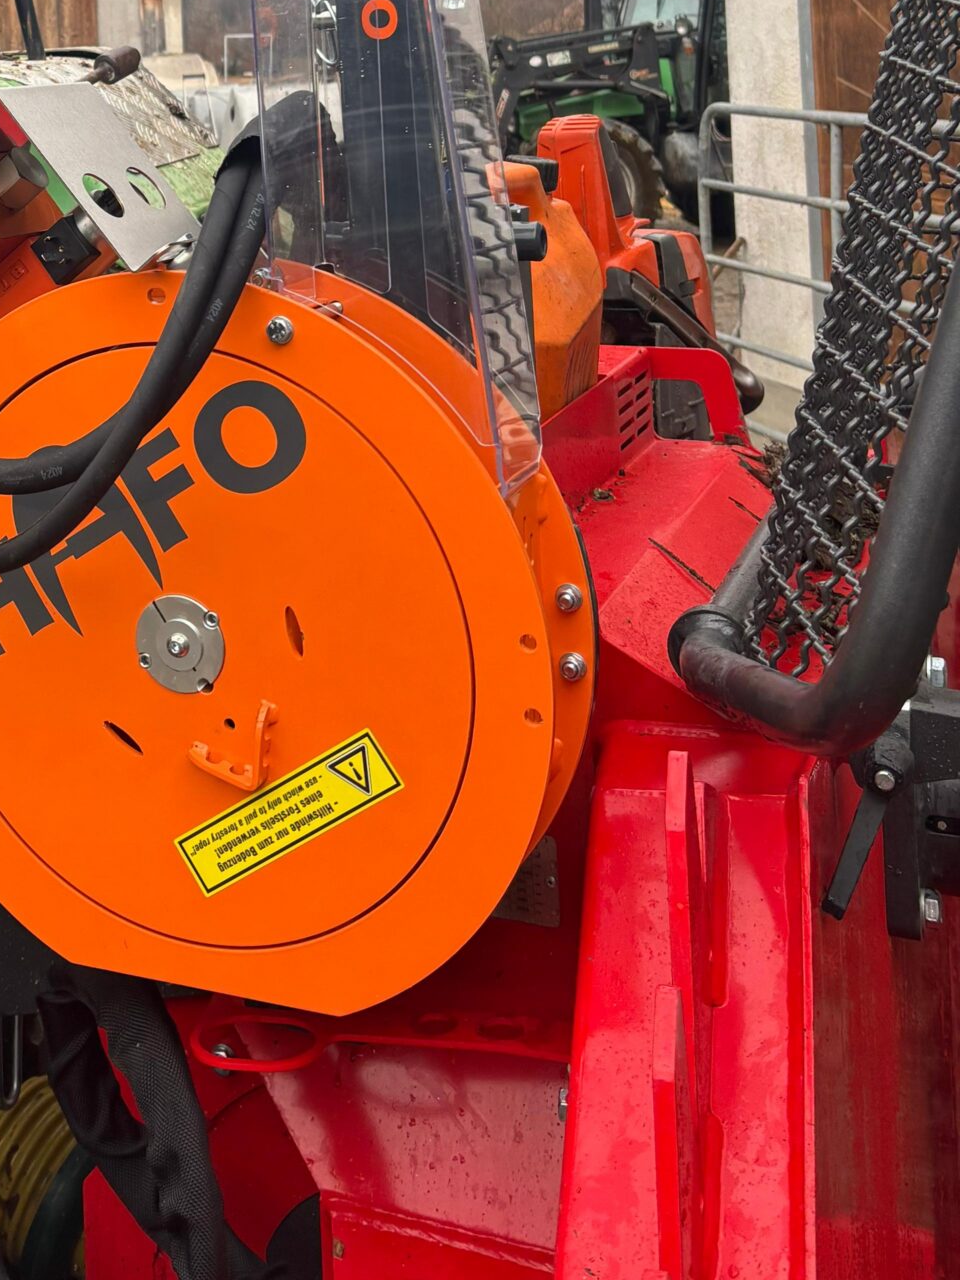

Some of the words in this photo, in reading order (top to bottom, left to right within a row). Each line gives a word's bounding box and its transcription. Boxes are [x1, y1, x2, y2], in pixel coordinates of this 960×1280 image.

[305, 777, 318, 788] use
[283, 785, 304, 802] winch
[300, 790, 323, 807] eines
[258, 806, 267, 815] to
[267, 797, 282, 810] only
[244, 809, 258, 825] pull
[260, 803, 301, 830] Forstseils
[290, 803, 334, 831] Hilfswinde
[211, 823, 238, 842] forestry
[275, 828, 289, 840] nur
[214, 826, 261, 858] verwenden!
[257, 836, 274, 850] zum
[217, 846, 258, 872] Bodenzug
